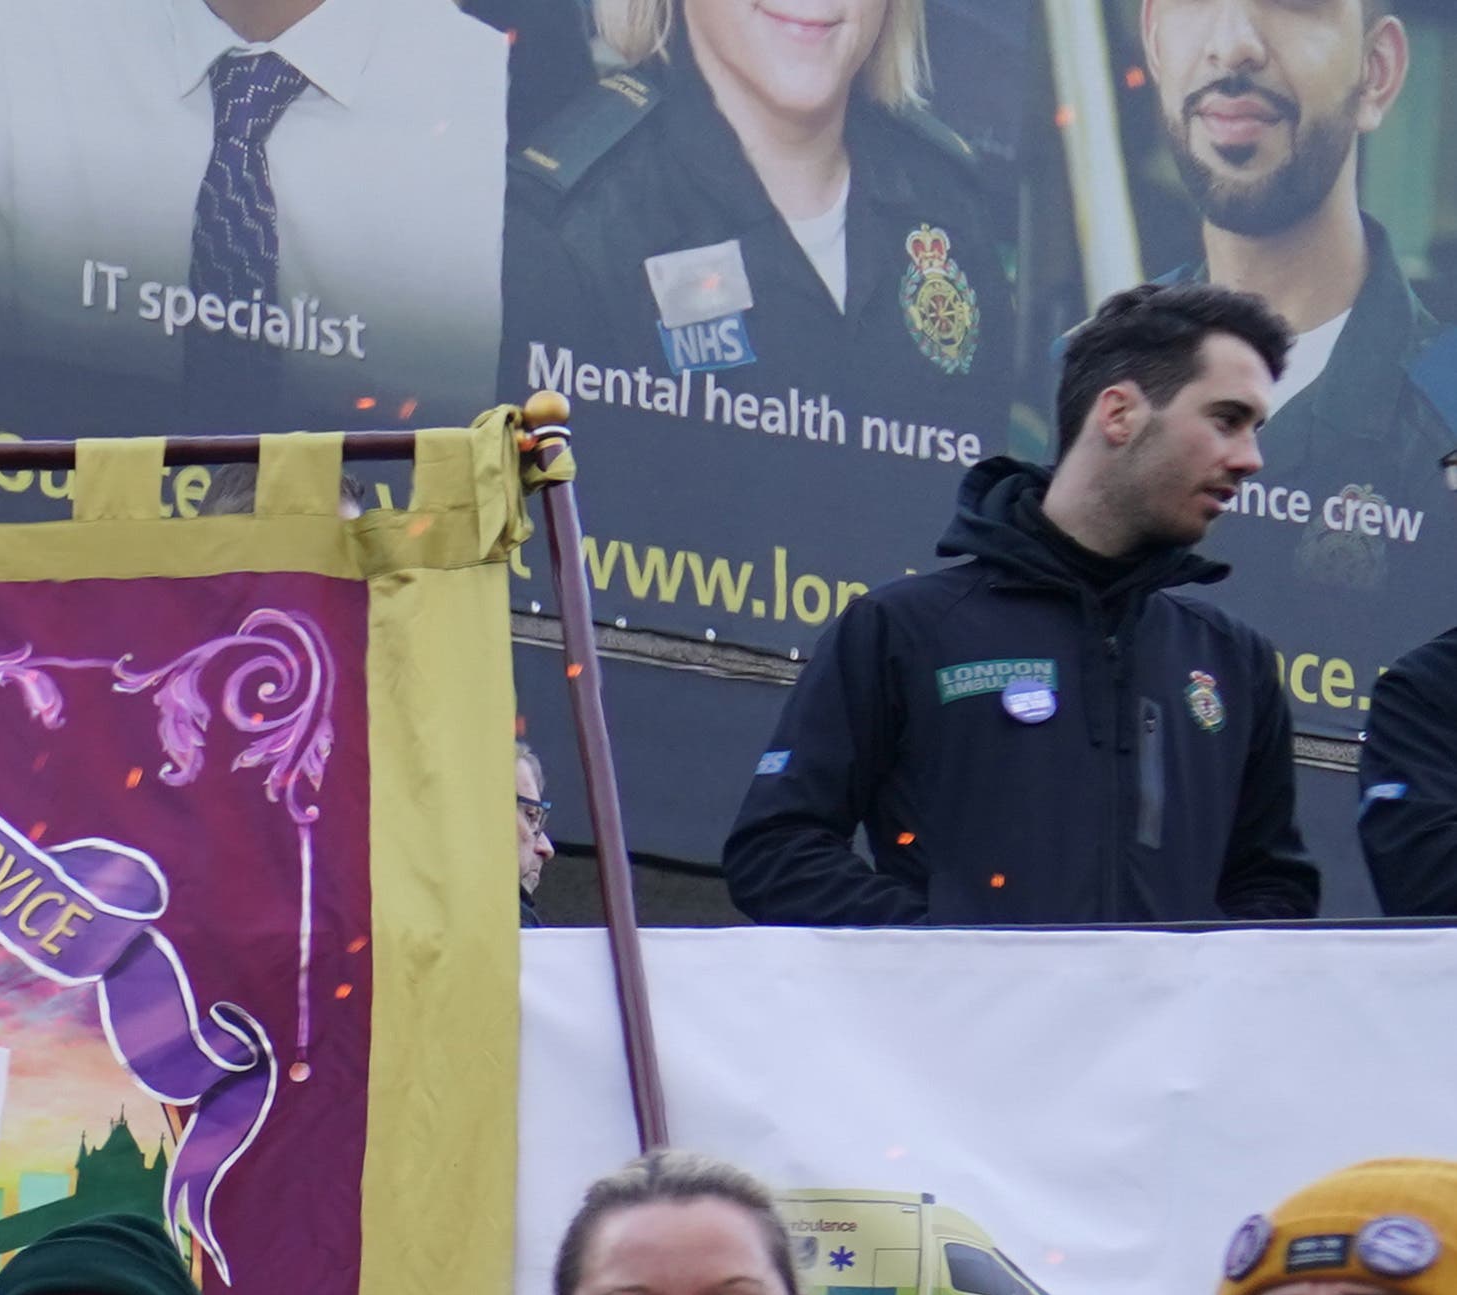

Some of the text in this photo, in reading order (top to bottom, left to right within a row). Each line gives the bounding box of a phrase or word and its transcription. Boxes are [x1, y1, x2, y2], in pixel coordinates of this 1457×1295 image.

[81, 260, 366, 360] IT specialist
[672, 318, 744, 368] NHS
[527, 341, 982, 467] Mental health nurse
[1323, 495, 1424, 542] crew
[941, 661, 1054, 685] LONDON
